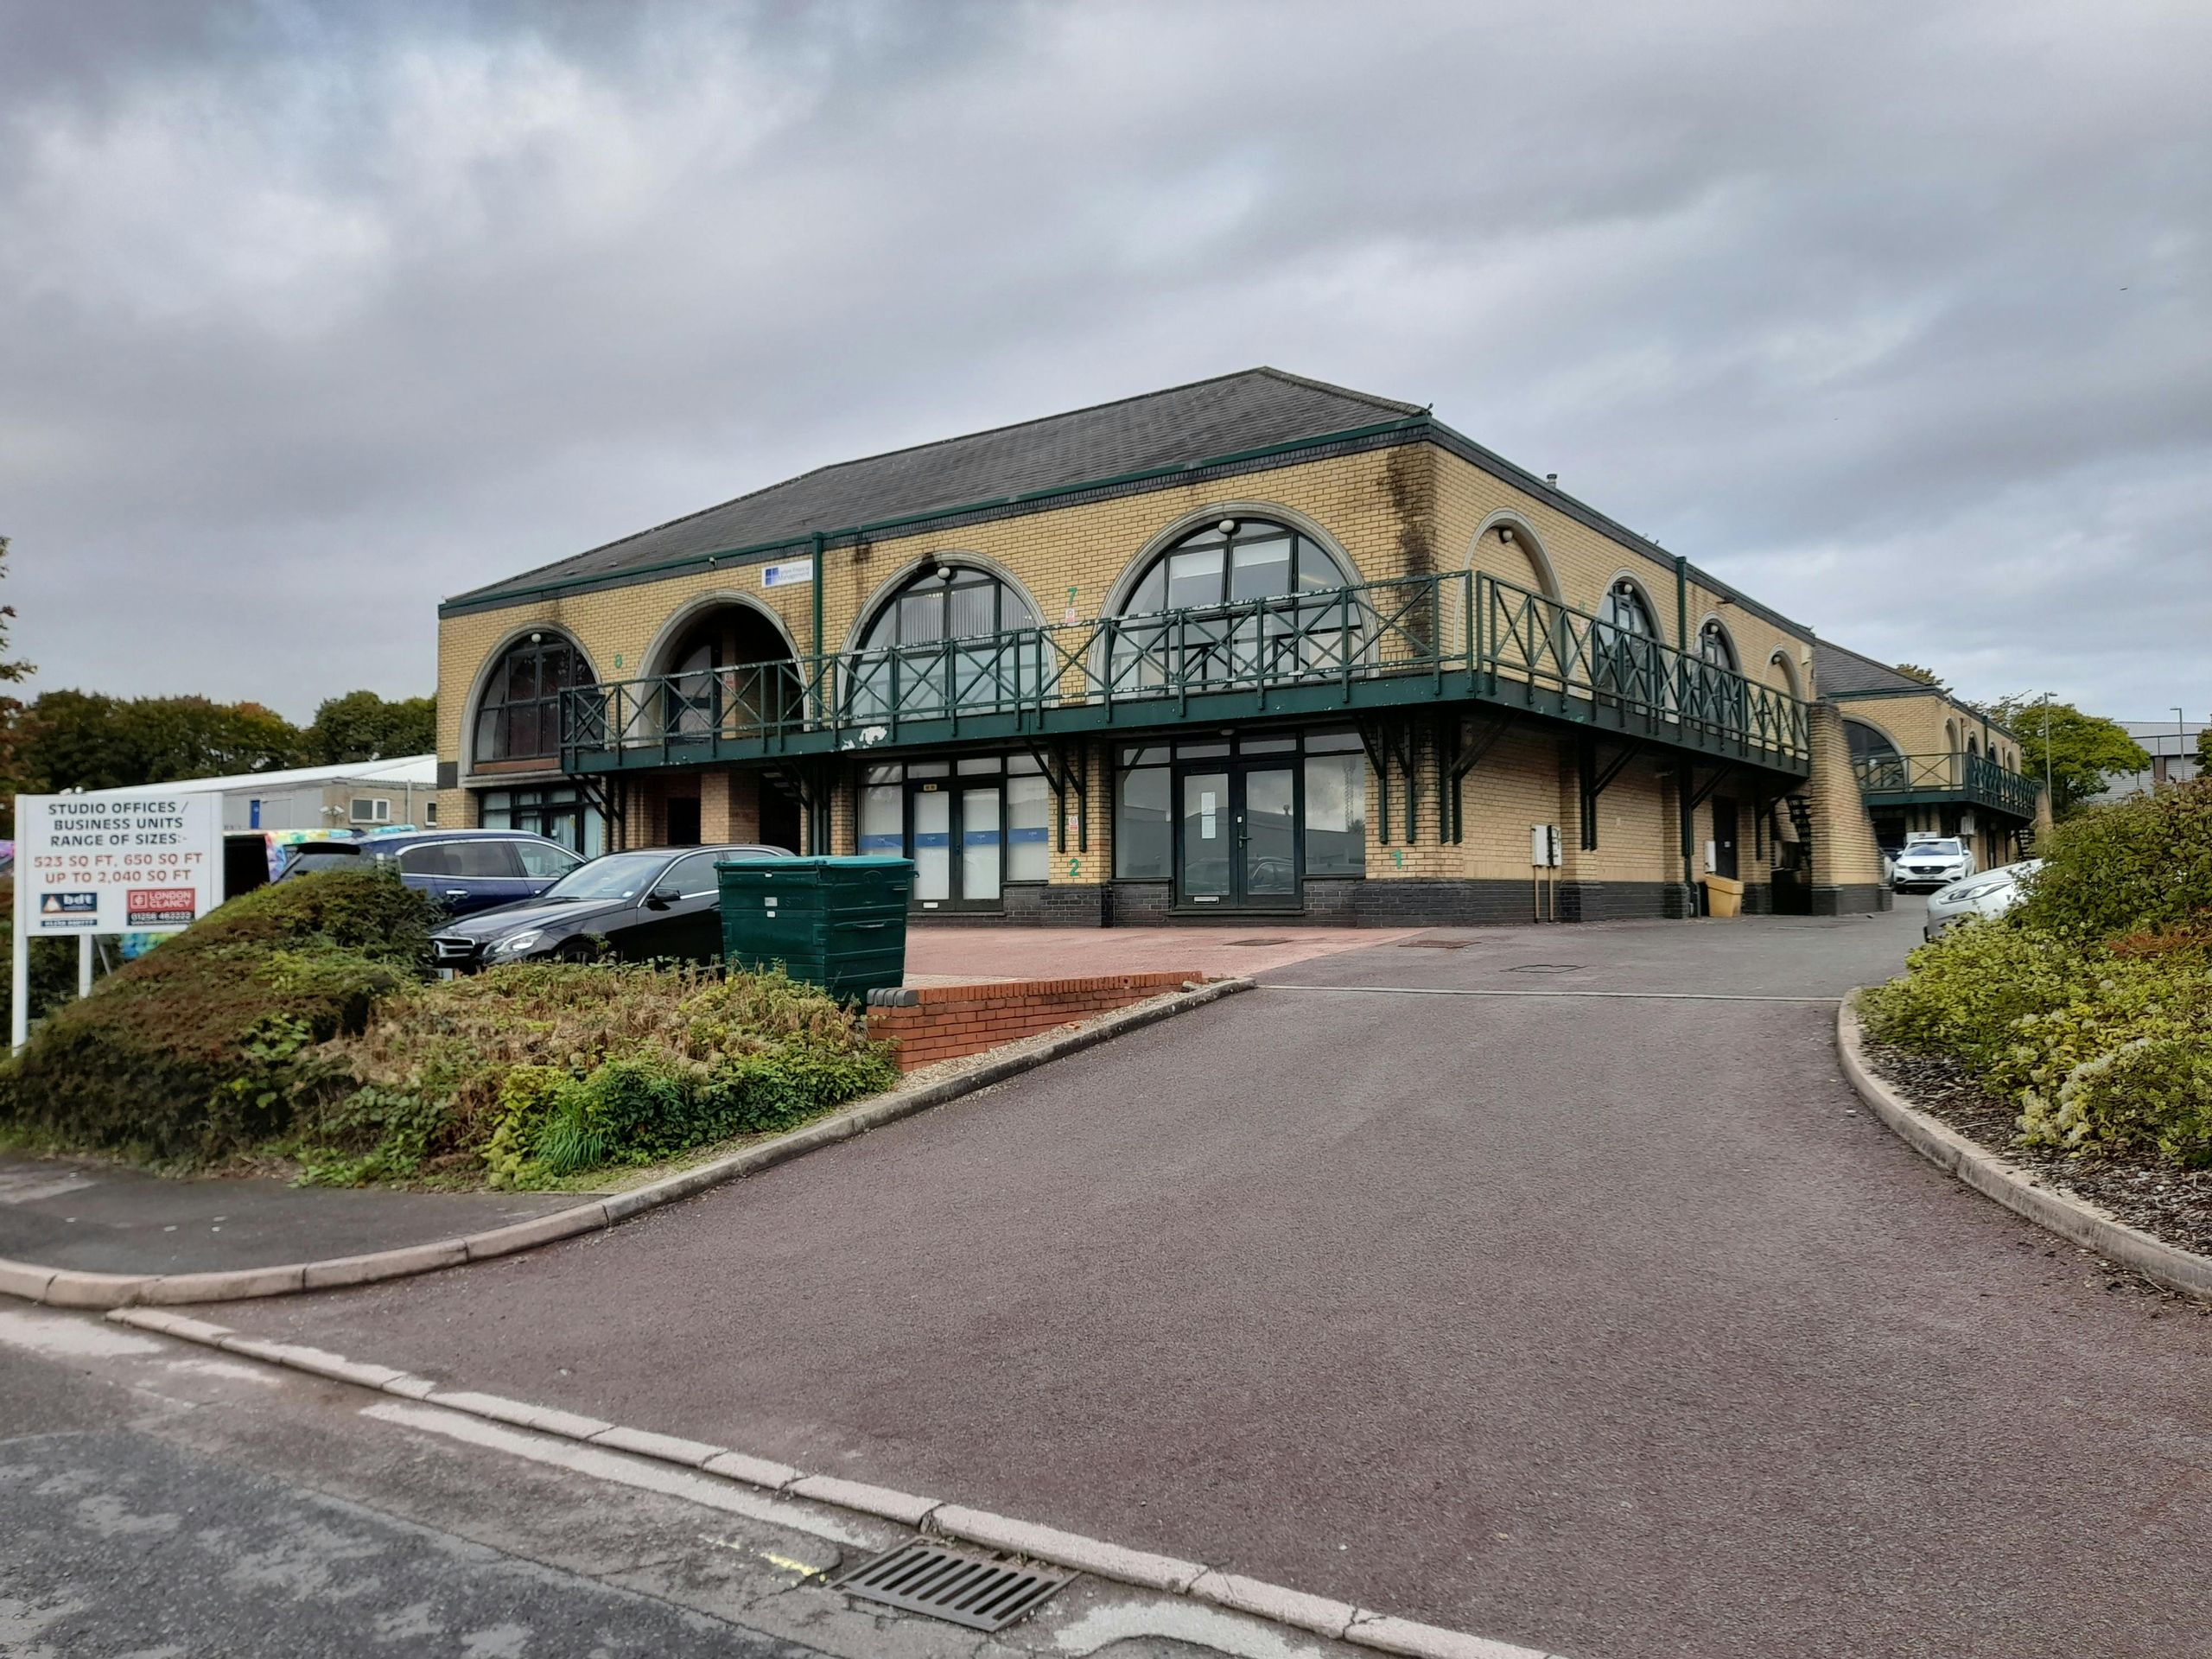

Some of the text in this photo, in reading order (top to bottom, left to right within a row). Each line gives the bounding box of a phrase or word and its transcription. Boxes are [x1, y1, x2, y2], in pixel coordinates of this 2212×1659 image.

[1067, 586, 1077, 607] 7
[48, 801, 188, 815] STUDIO OFFICES /
[54, 817, 183, 830] BUSINESS UNITS
[50, 835, 104, 847] RANGE
[110, 834, 130, 845] OF
[34, 855, 62, 868] 523
[69, 855, 88, 867] SQ
[124, 854, 153, 865] 650
[158, 853, 178, 865] SQ
[184, 852, 203, 864] FT
[1391, 849, 1402, 870] 1
[1069, 858, 1079, 876] 2
[46, 869, 191, 884] UP TO 2,040 SQ FT
[63, 893, 92, 905] bdt
[149, 891, 191, 900] LONDON
[149, 899, 191, 908] CLANCY
